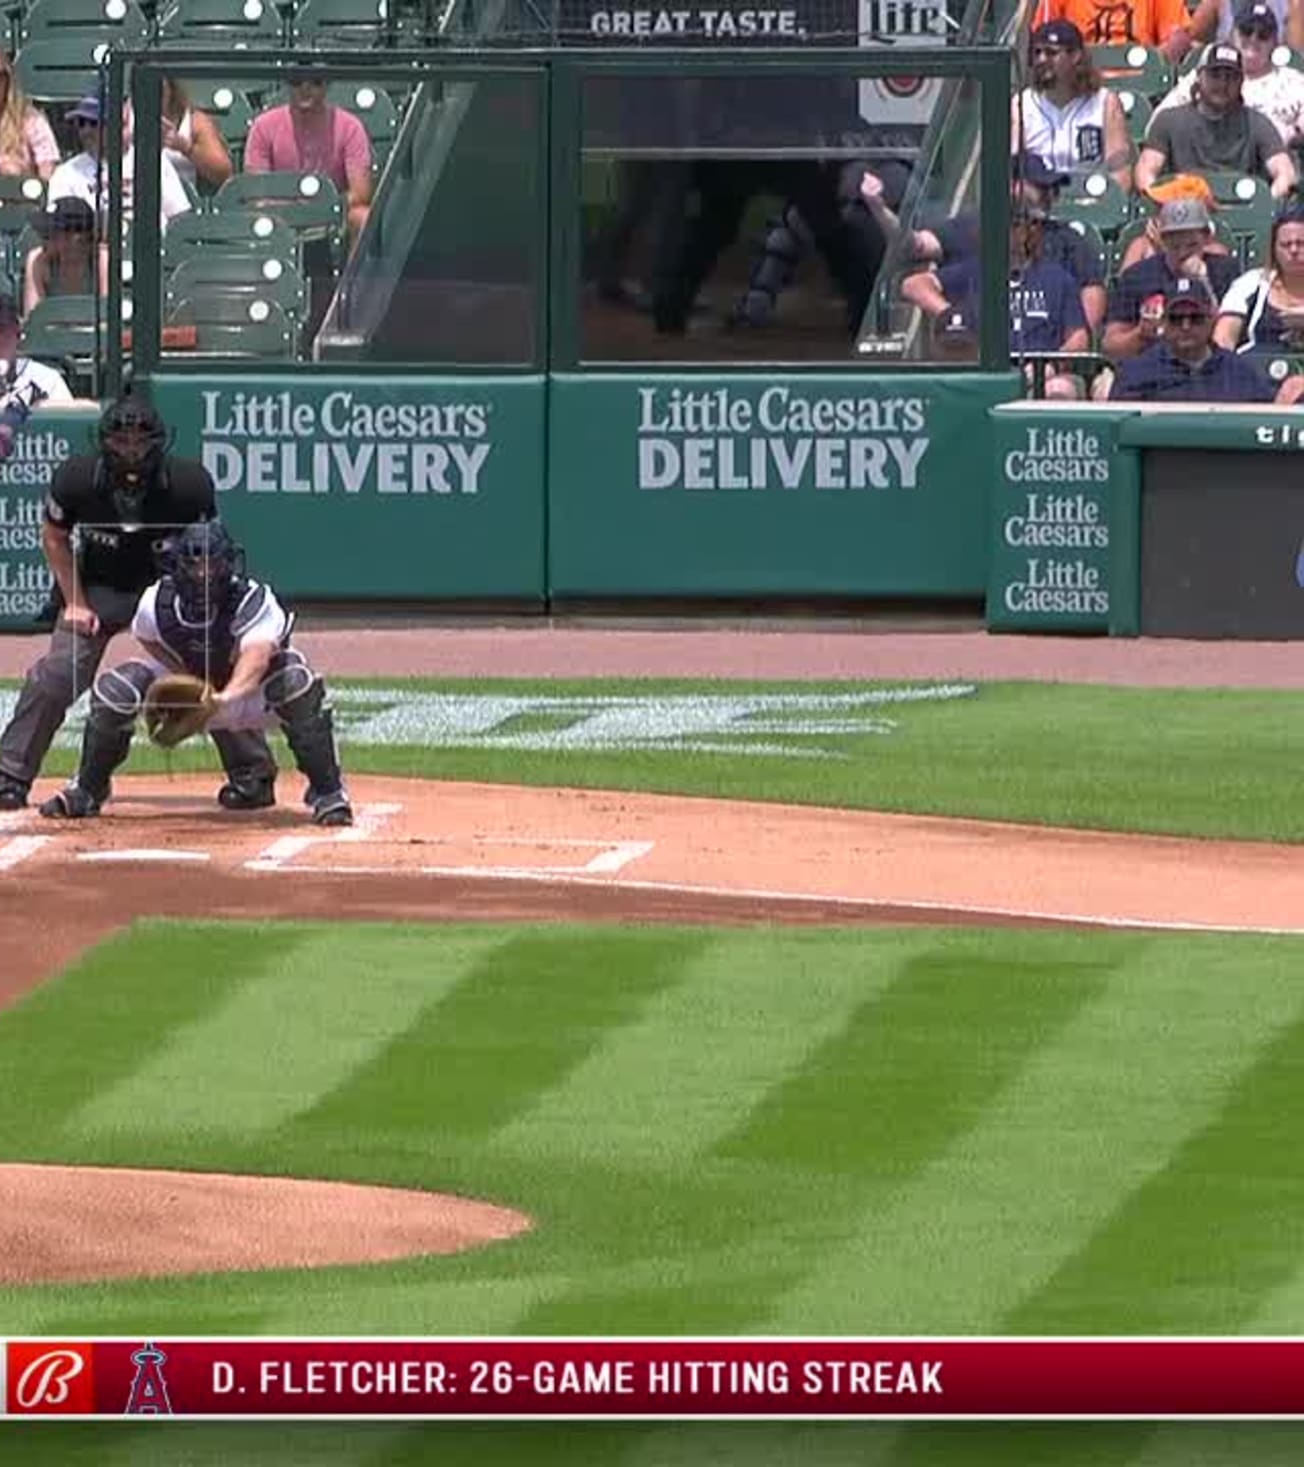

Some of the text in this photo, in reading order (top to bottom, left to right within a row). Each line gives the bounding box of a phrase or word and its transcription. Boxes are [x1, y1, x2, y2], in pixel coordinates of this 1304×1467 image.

[591, 10, 807, 36] GREAT TASTE.
[201, 391, 488, 437] Little Caesars
[638, 387, 925, 433] Little Caesars
[1026, 427, 1099, 457] Little
[202, 442, 491, 493] DELIVERY
[638, 438, 930, 489] DELIVERY
[1005, 451, 1109, 481] Caesars
[1026, 494, 1099, 523] Little
[1005, 516, 1109, 547] Caesars
[1026, 559, 1099, 589] Little
[1005, 582, 1109, 613] Caesars
